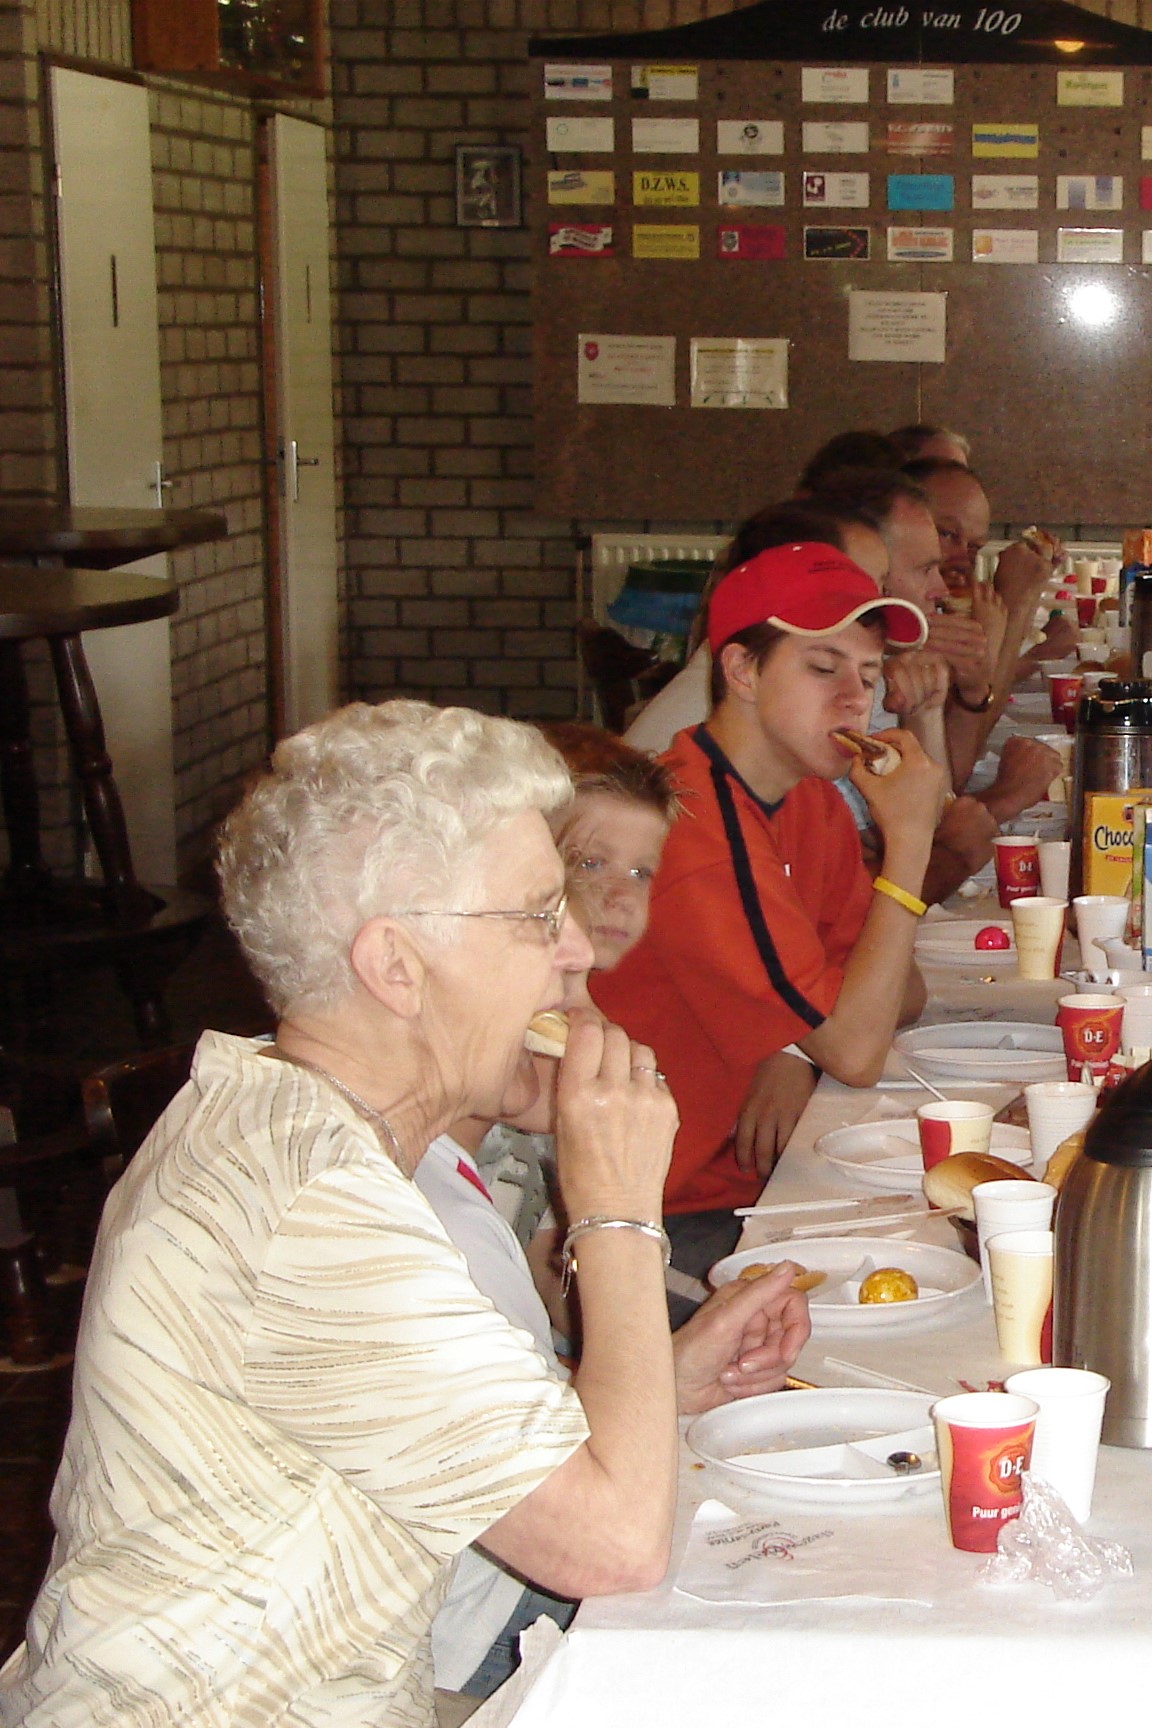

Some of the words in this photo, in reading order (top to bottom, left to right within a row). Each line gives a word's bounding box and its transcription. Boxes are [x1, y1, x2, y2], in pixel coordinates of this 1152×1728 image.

[822, 9, 848, 31] de
[859, 6, 909, 28] club
[922, 11, 961, 28] van
[972, 8, 1022, 35] 100
[972, 1506, 999, 1518] Puur
